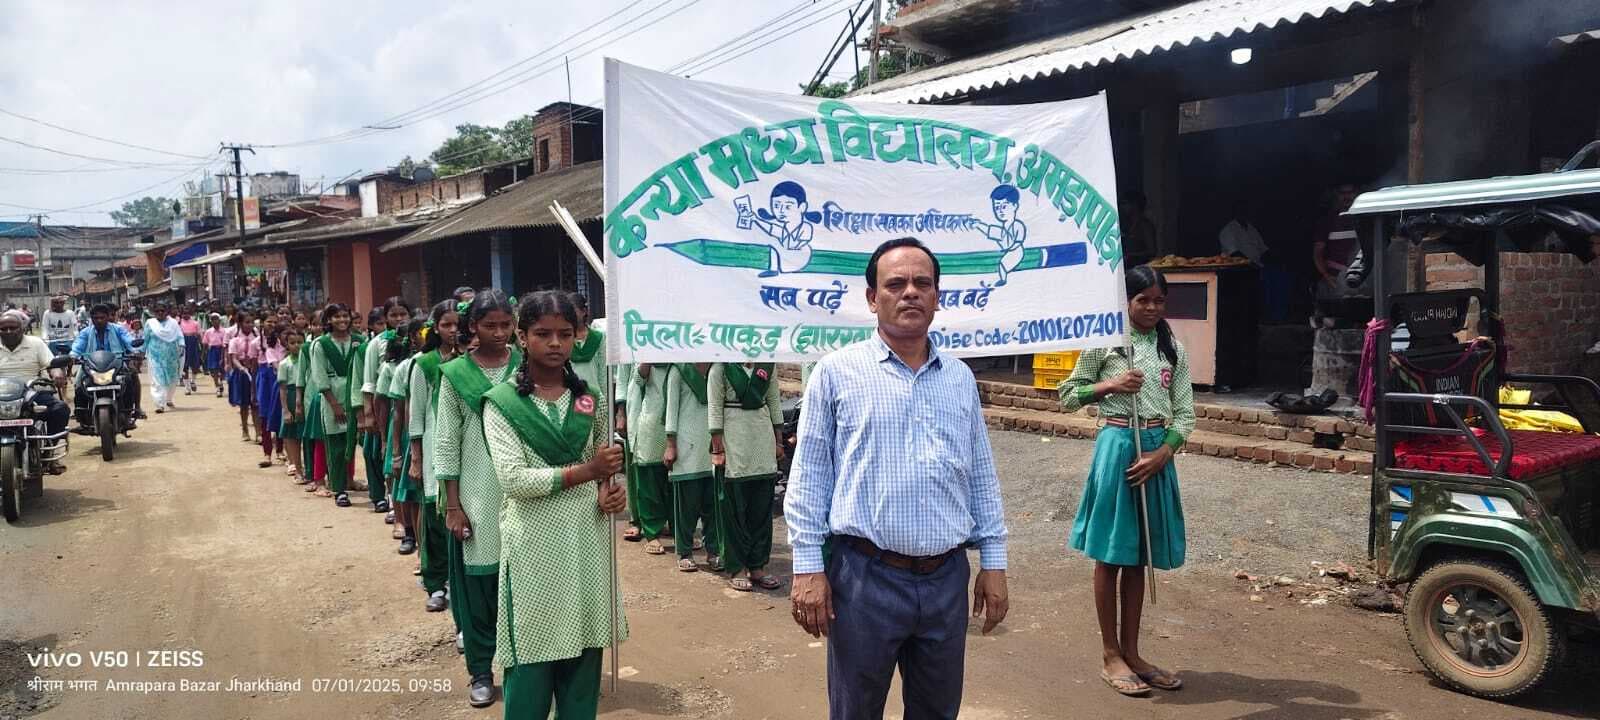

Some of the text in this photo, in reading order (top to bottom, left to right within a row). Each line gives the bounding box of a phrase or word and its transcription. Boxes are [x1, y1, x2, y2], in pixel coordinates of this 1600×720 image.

[604, 151, 714, 258] कन्या
[699, 117, 825, 189] मध्य
[759, 285, 804, 311] सब
[928, 326, 972, 349] Dise
